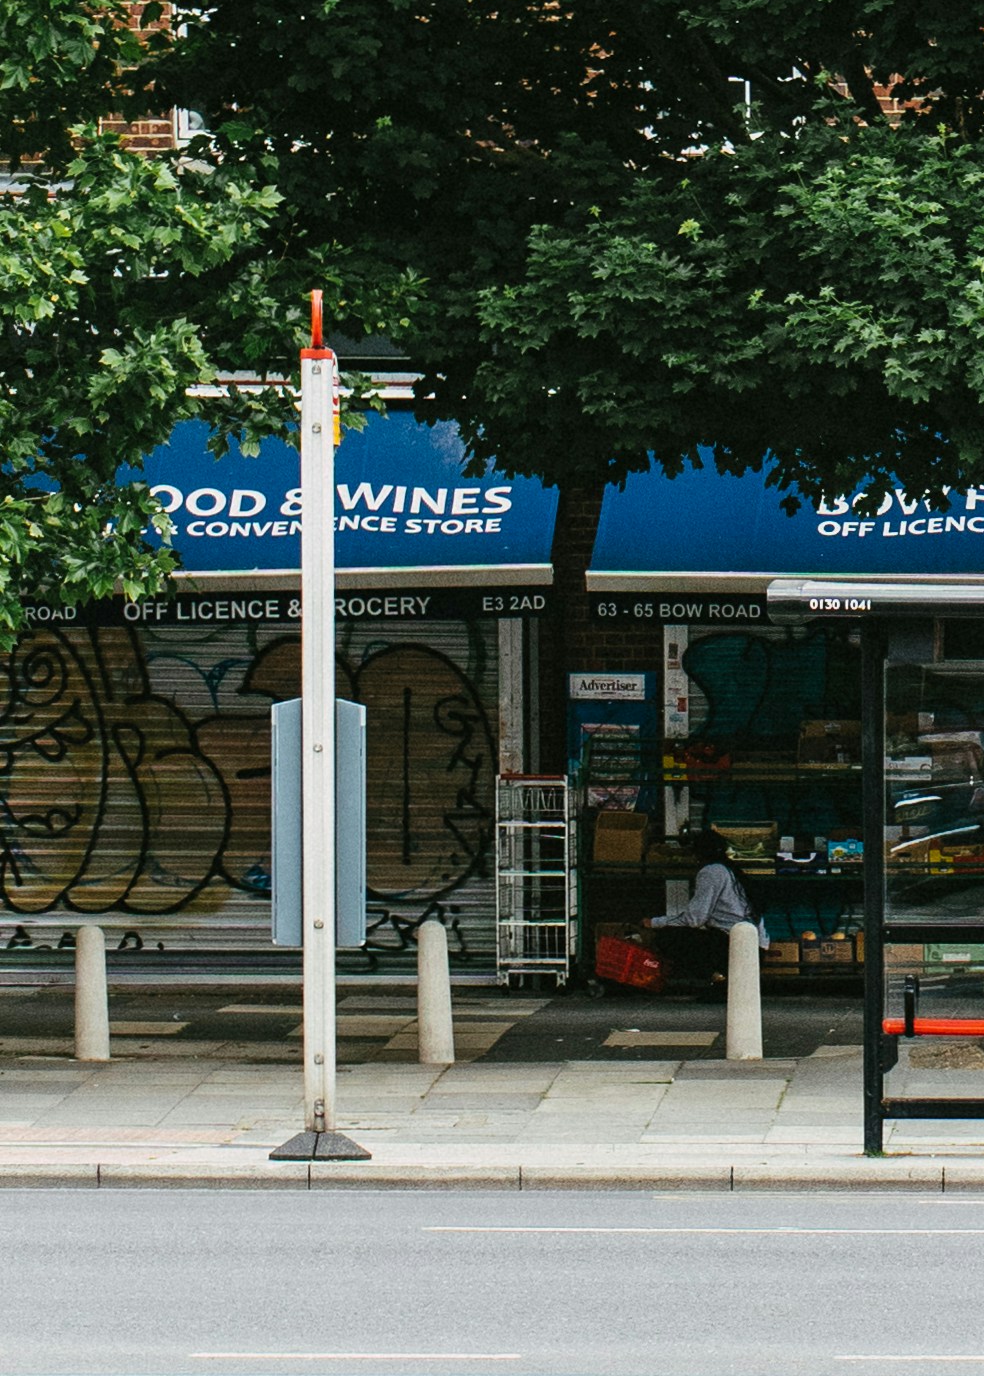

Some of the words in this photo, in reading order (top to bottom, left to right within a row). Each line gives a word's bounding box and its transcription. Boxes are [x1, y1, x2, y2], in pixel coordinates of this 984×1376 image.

[150, 484, 267, 518] OOD
[336, 481, 513, 515] WINES
[186, 514, 398, 537] CONVENNCE
[404, 517, 502, 535] STORE
[817, 520, 876, 537] OFF
[123, 602, 169, 621] OFF
[176, 600, 280, 621] LICENCE
[335, 596, 431, 616] ROCERY
[482, 596, 504, 612] E3
[510, 595, 546, 611] 2AD
[598, 602, 618, 617] 63
[634, 603, 654, 618] 65
[659, 603, 703, 619] BOW
[709, 604, 761, 619] ROAD
[809, 598, 841, 611] 0130
[845, 598, 872, 611] 1041
[25, 605, 77, 621] ROAD
[579, 679, 637, 692] Advertiser
